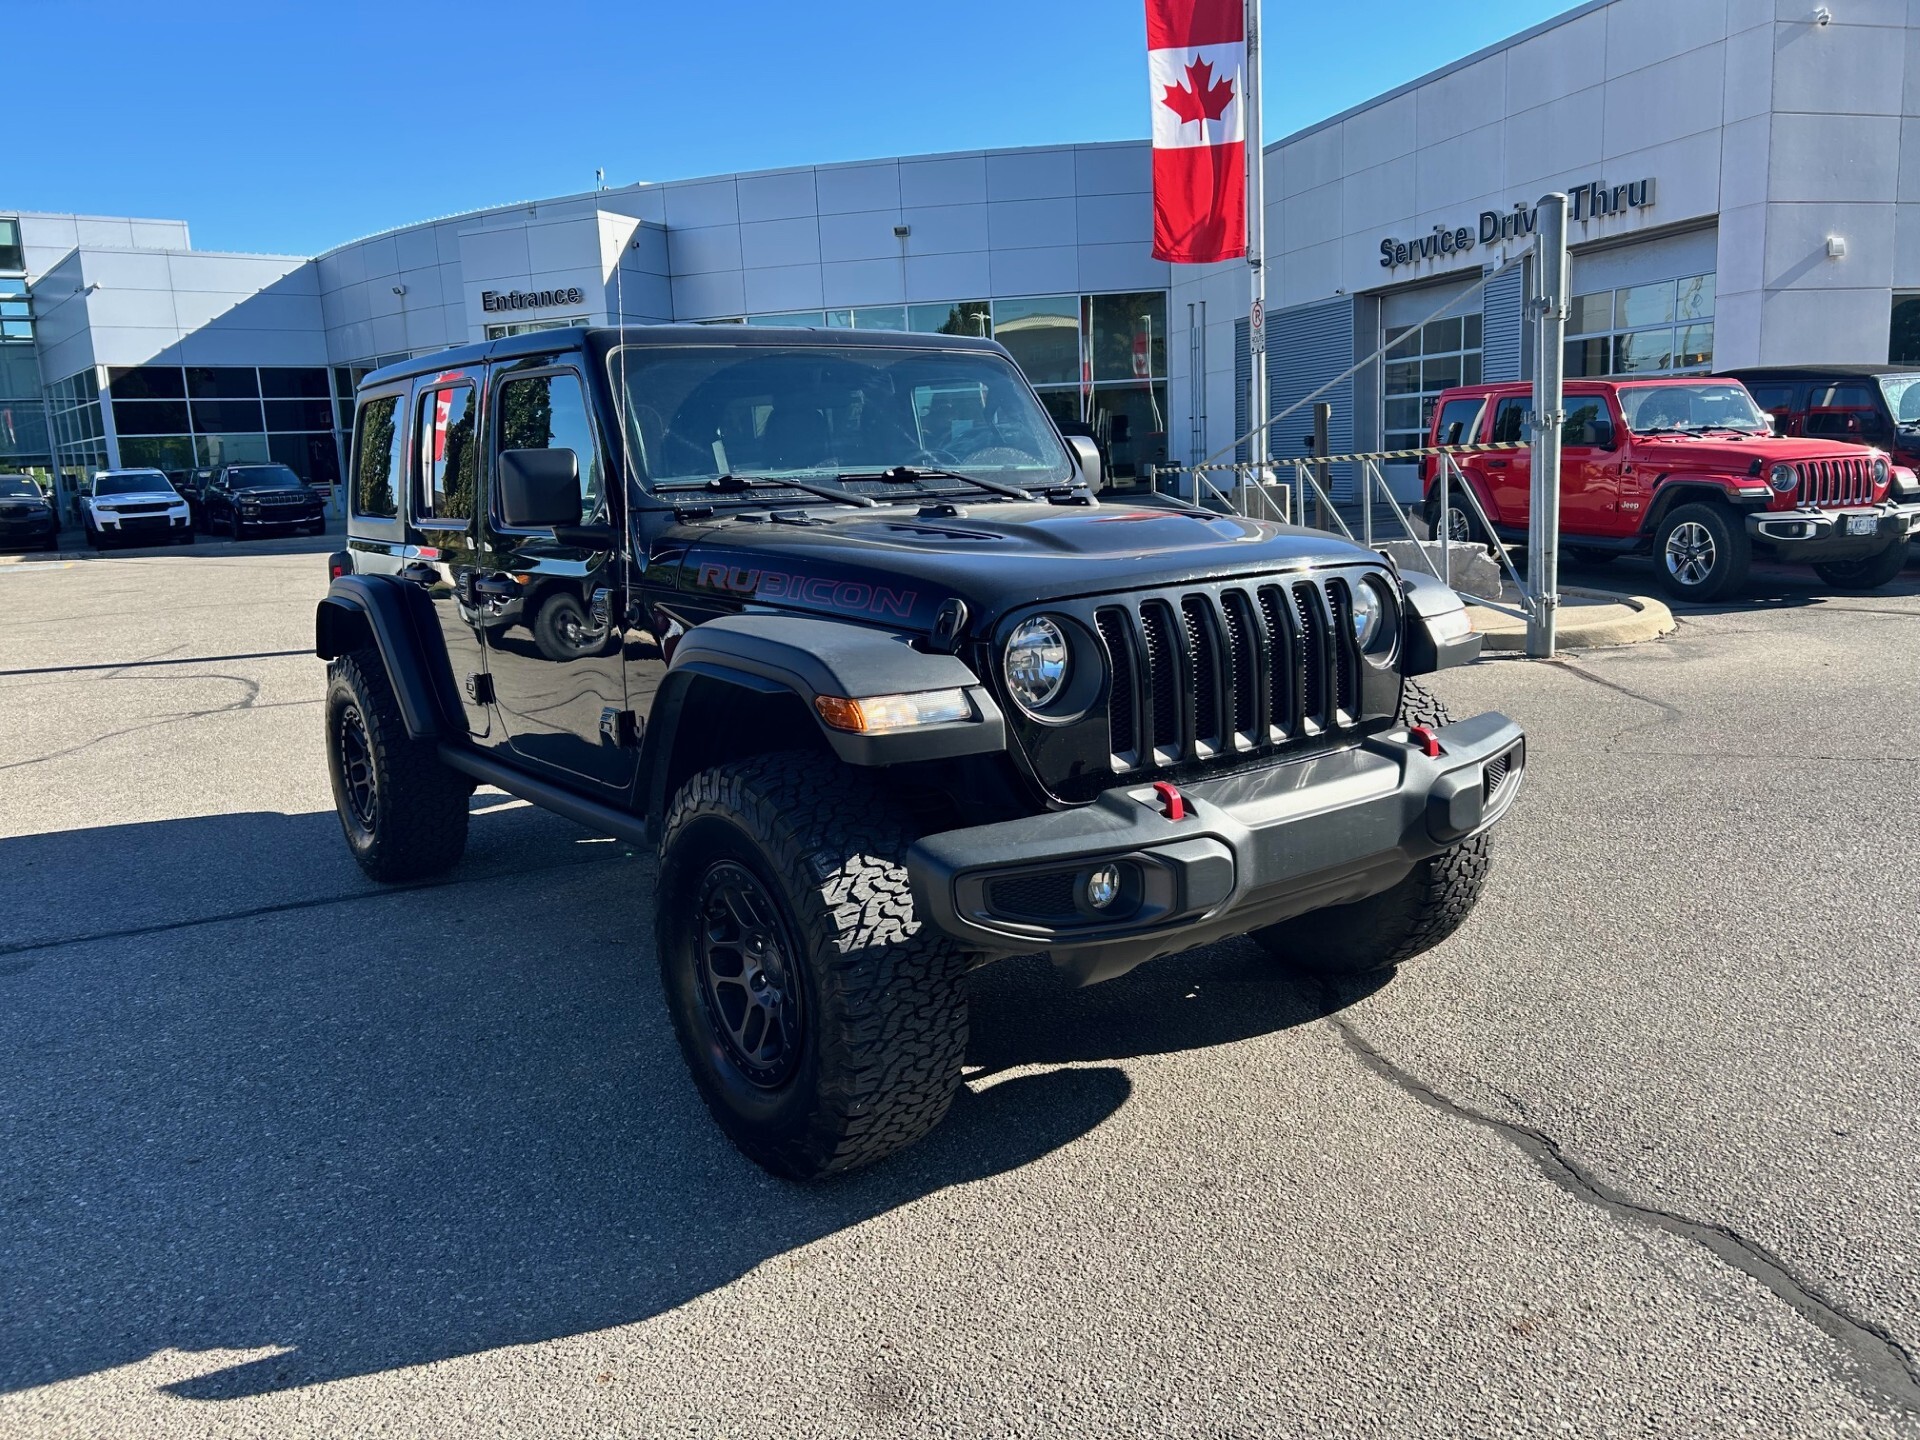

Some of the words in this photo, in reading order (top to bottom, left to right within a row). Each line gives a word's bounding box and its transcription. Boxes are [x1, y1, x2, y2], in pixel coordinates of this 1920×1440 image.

[1380, 225, 1472, 267] Service
[481, 287, 581, 312] Entrance
[1252, 335, 1264, 343] ROUTE
[1621, 501, 1640, 509] Jeep
[697, 562, 918, 618] RUBICON
